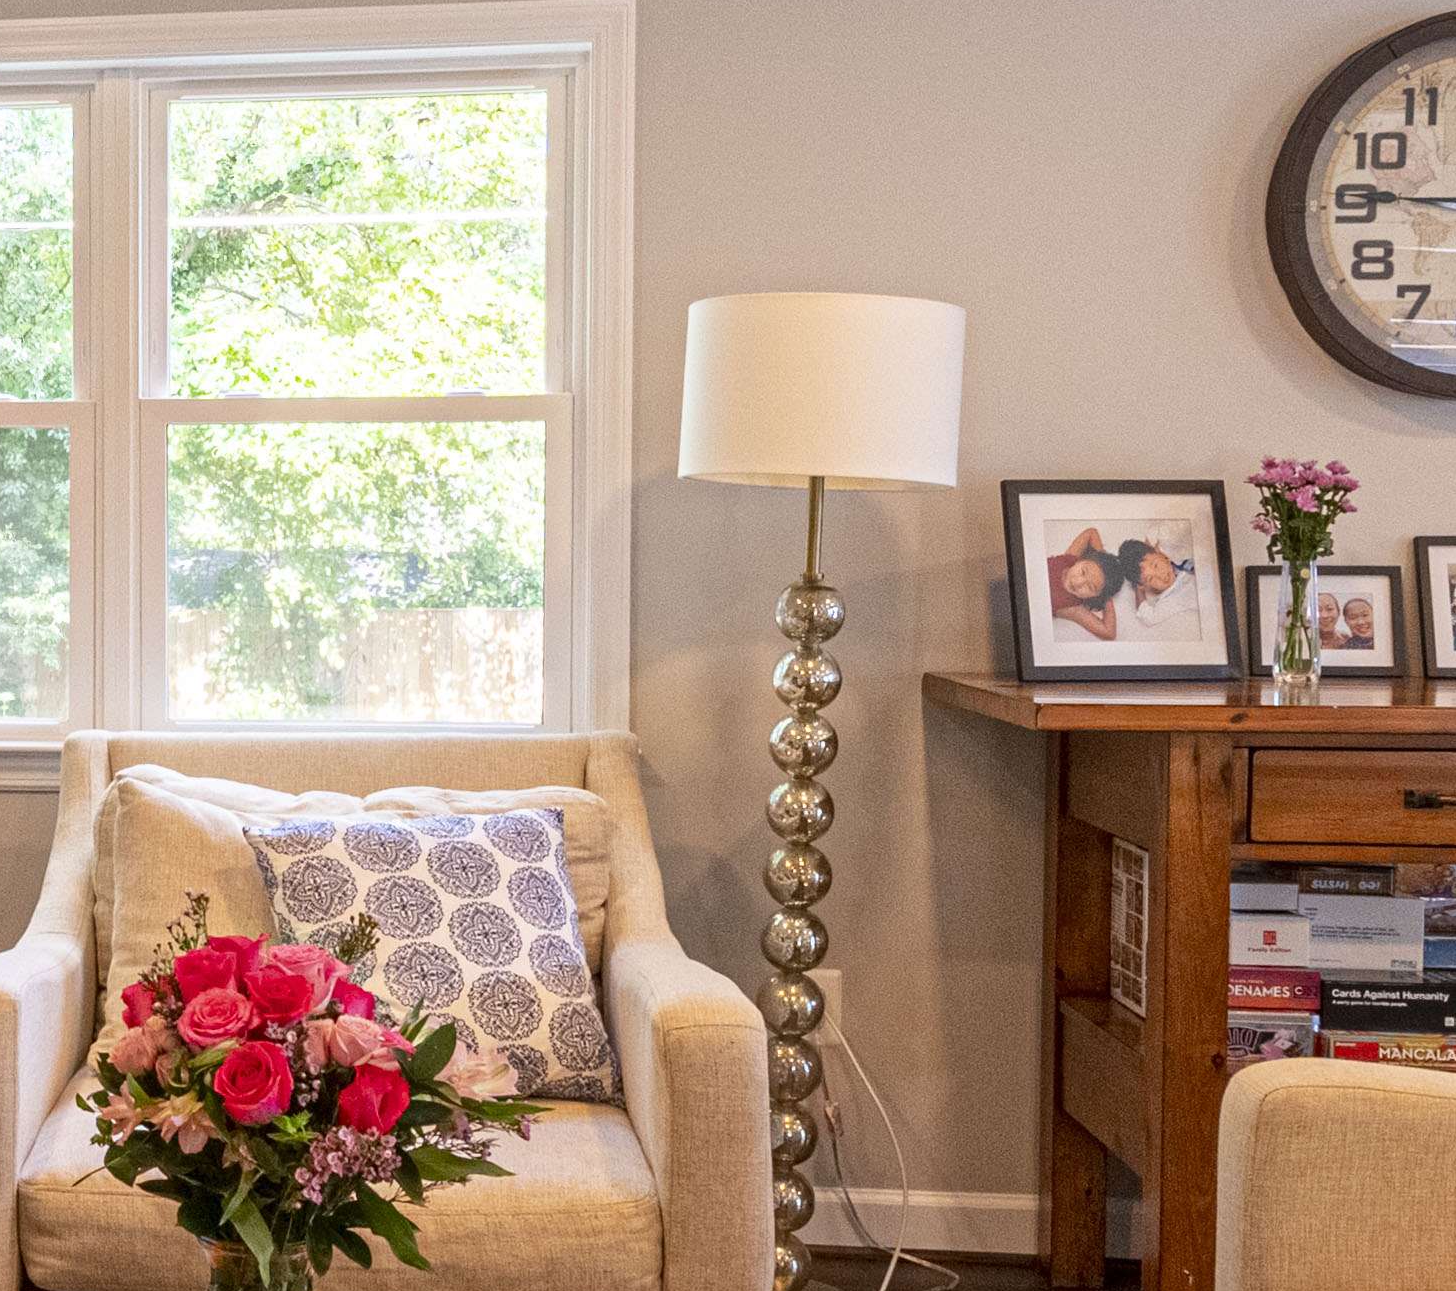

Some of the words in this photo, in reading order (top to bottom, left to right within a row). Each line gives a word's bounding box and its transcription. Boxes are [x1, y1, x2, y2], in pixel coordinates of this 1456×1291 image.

[1402, 87, 1439, 127] 11
[1353, 131, 1407, 171] 10
[1334, 183, 1378, 224] 9
[1350, 239, 1394, 281] 8
[1396, 284, 1431, 321] 7
[1331, 988, 1362, 999] Cards
[1363, 989, 1401, 1002] Against
[1402, 991, 1450, 1003] Humanity
